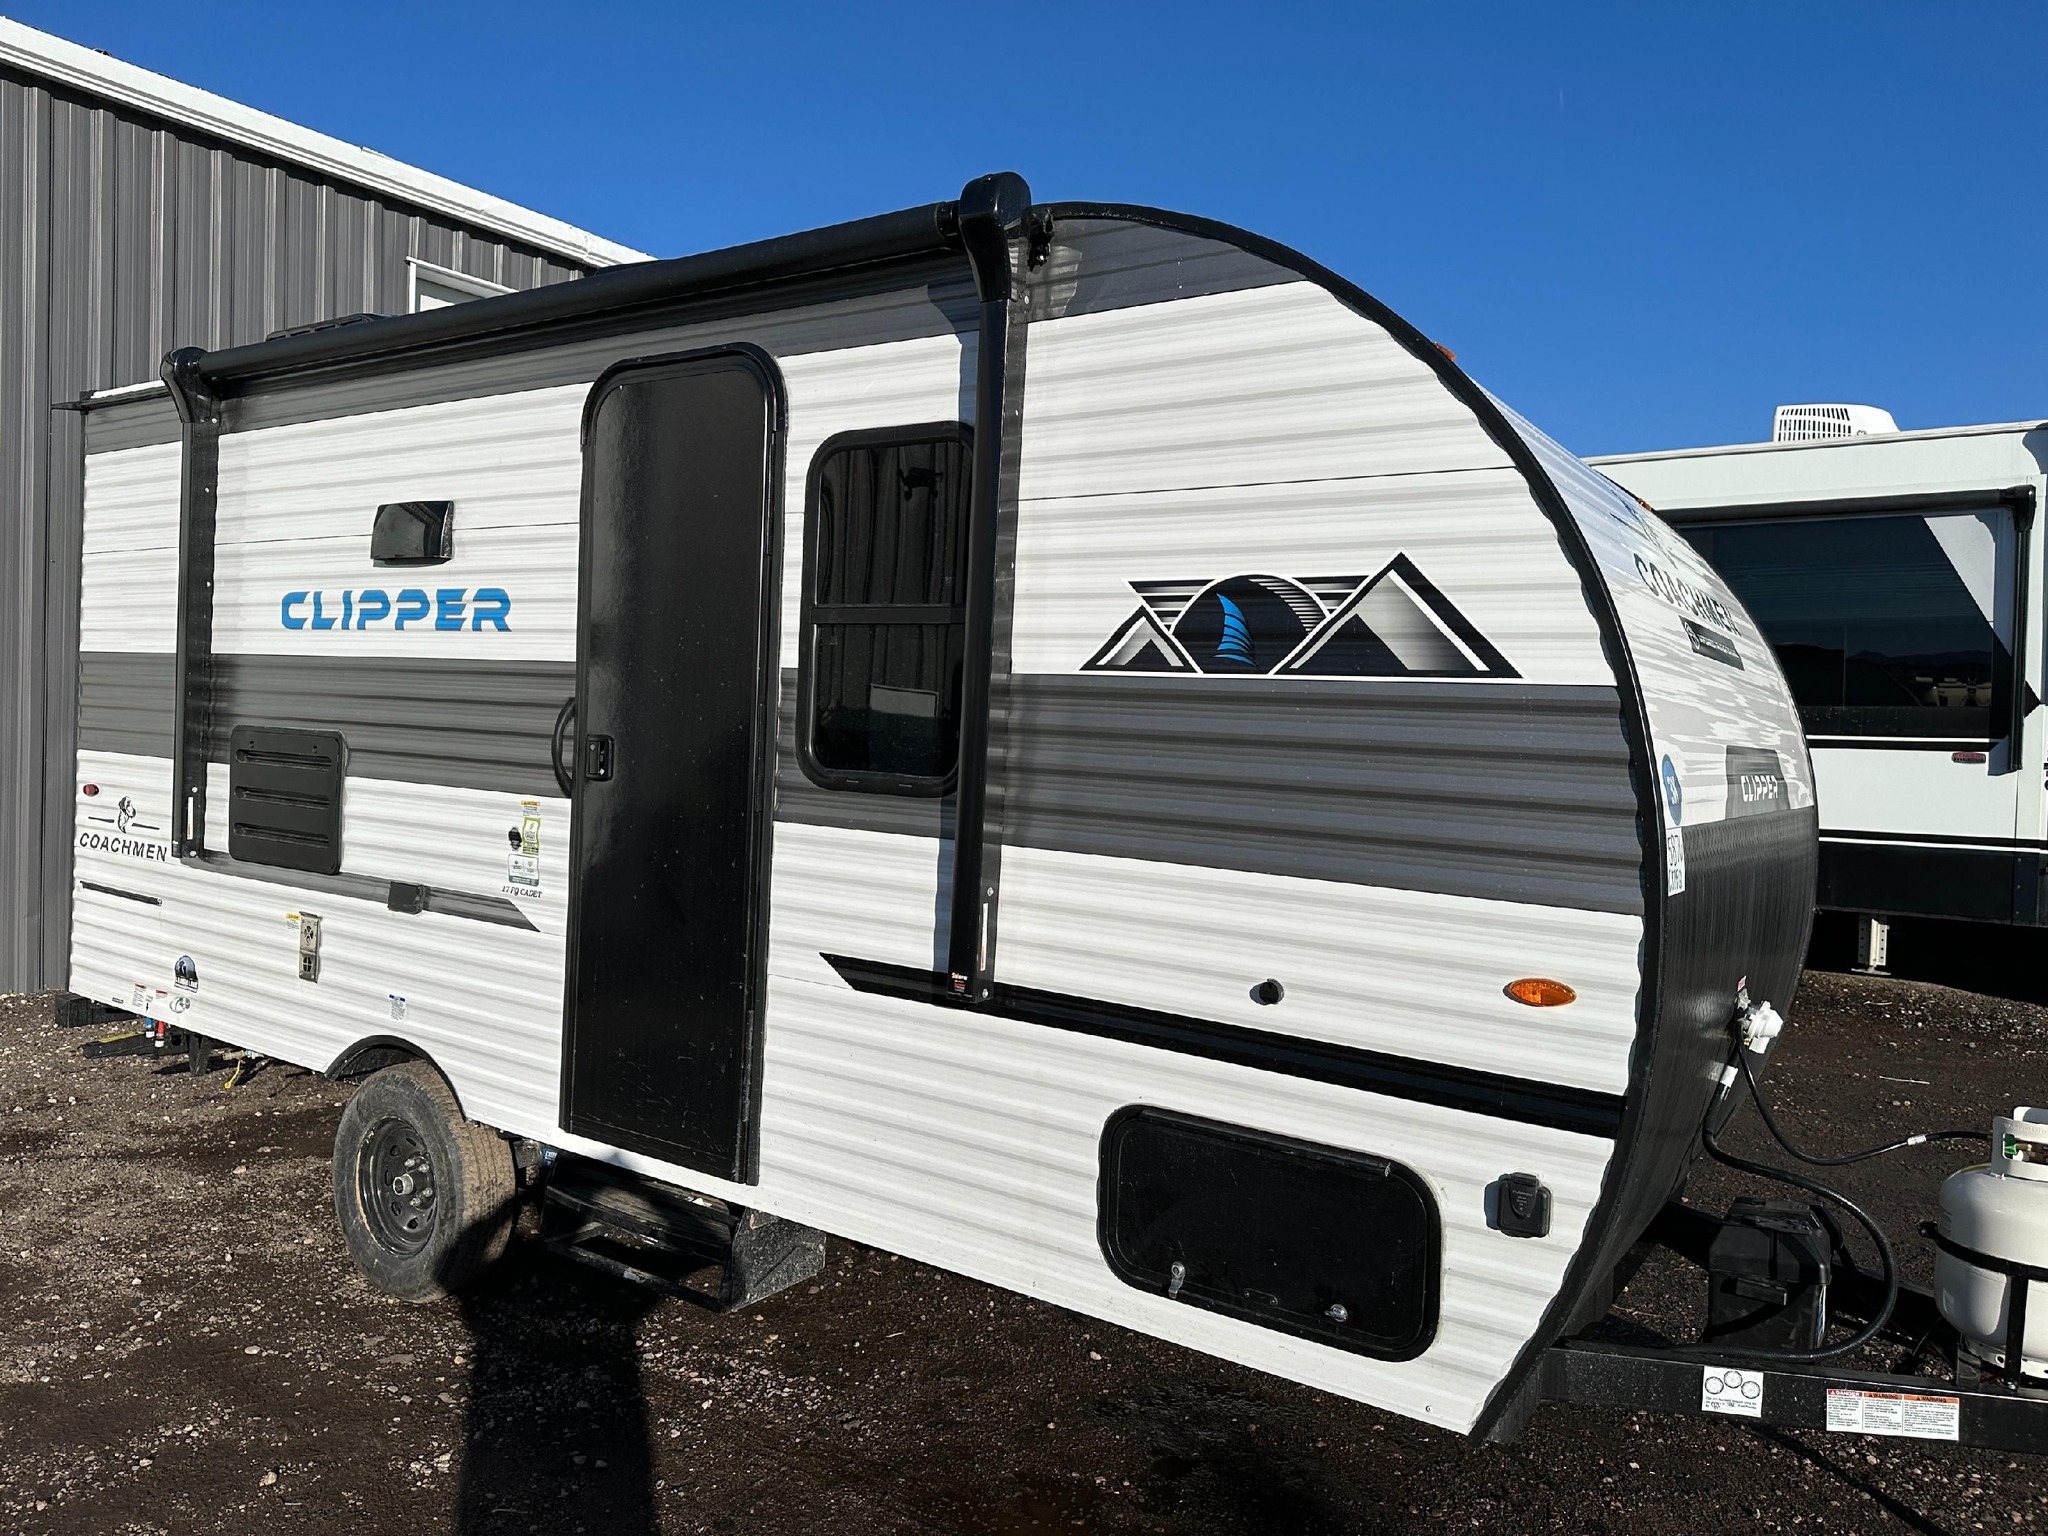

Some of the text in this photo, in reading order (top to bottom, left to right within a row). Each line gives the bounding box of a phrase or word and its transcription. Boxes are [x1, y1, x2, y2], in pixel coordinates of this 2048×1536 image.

[1634, 553, 1742, 637] COACHMEN
[281, 588, 512, 632] CLIPPER
[1740, 774, 1778, 802] CLIPPER
[79, 832, 167, 862] COACHMEN
[501, 885, 510, 893] 17
[520, 888, 543, 898] CADET
[1872, 1392, 1899, 1400] WARNING
